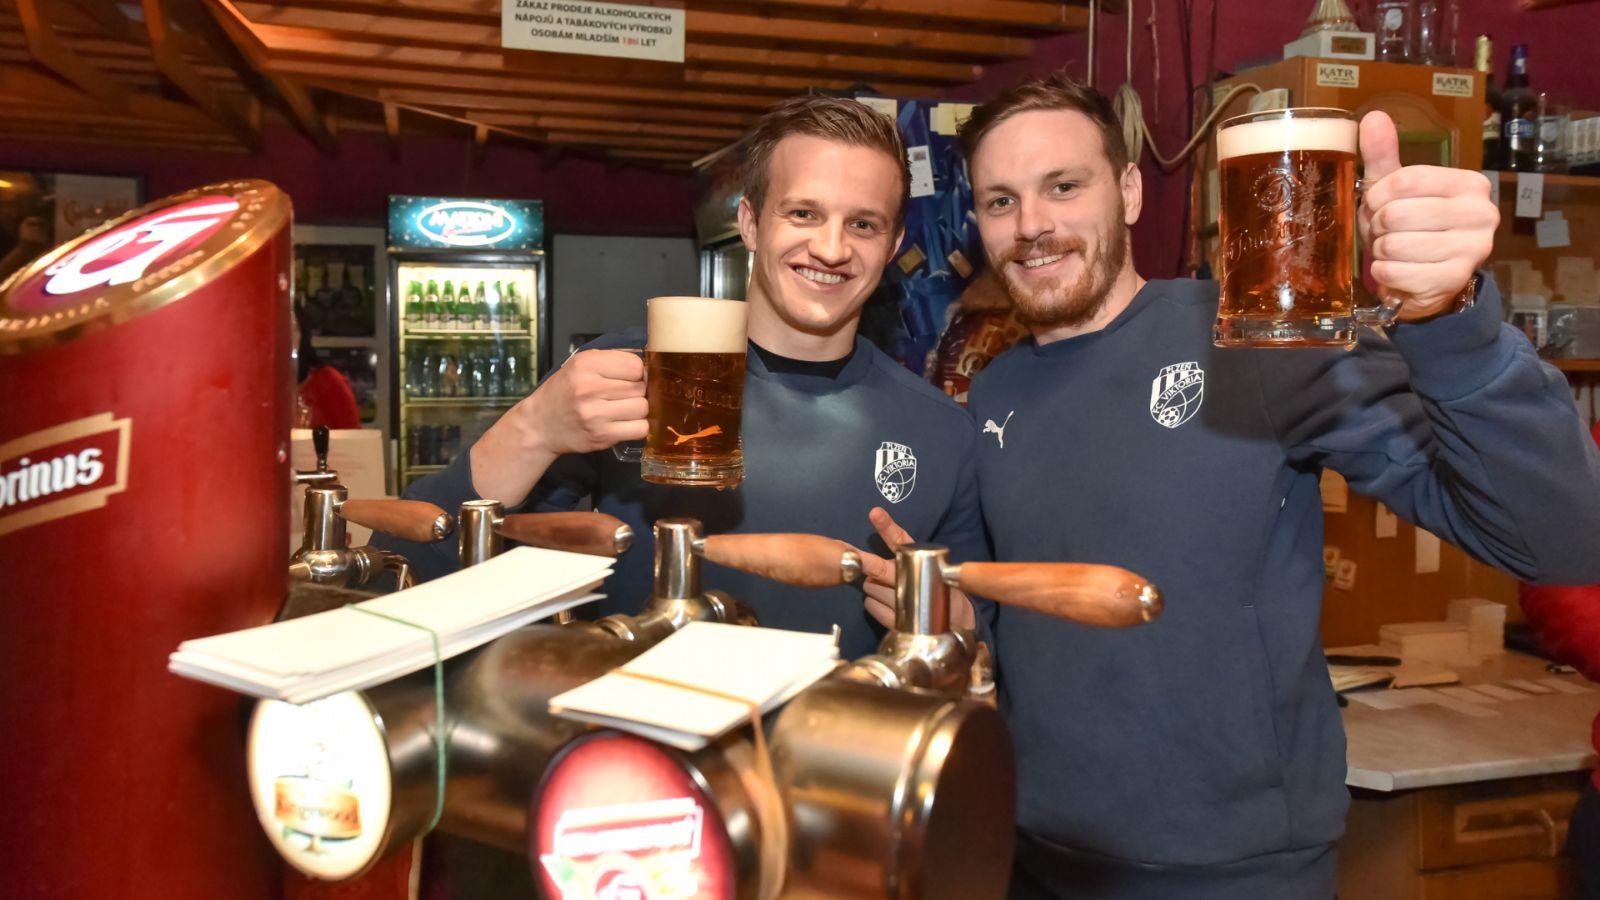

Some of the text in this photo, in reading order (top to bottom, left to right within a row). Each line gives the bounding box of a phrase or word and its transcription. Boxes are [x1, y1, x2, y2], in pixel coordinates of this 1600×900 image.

[550, 3, 592, 14] PRODEJE
[595, 7, 672, 22] ALKOHOLICKÝCH
[515, 12, 673, 35] NÁPOJŮ A TABÁKOVÝCH VÝROBKŮ
[531, 28, 573, 39] OSOBÁM
[575, 31, 619, 43] MLADŠÍM
[641, 39, 657, 48] LET
[1152, 374, 1202, 414] FC VIKTORIA
[883, 459, 915, 474] VIKTORIA
